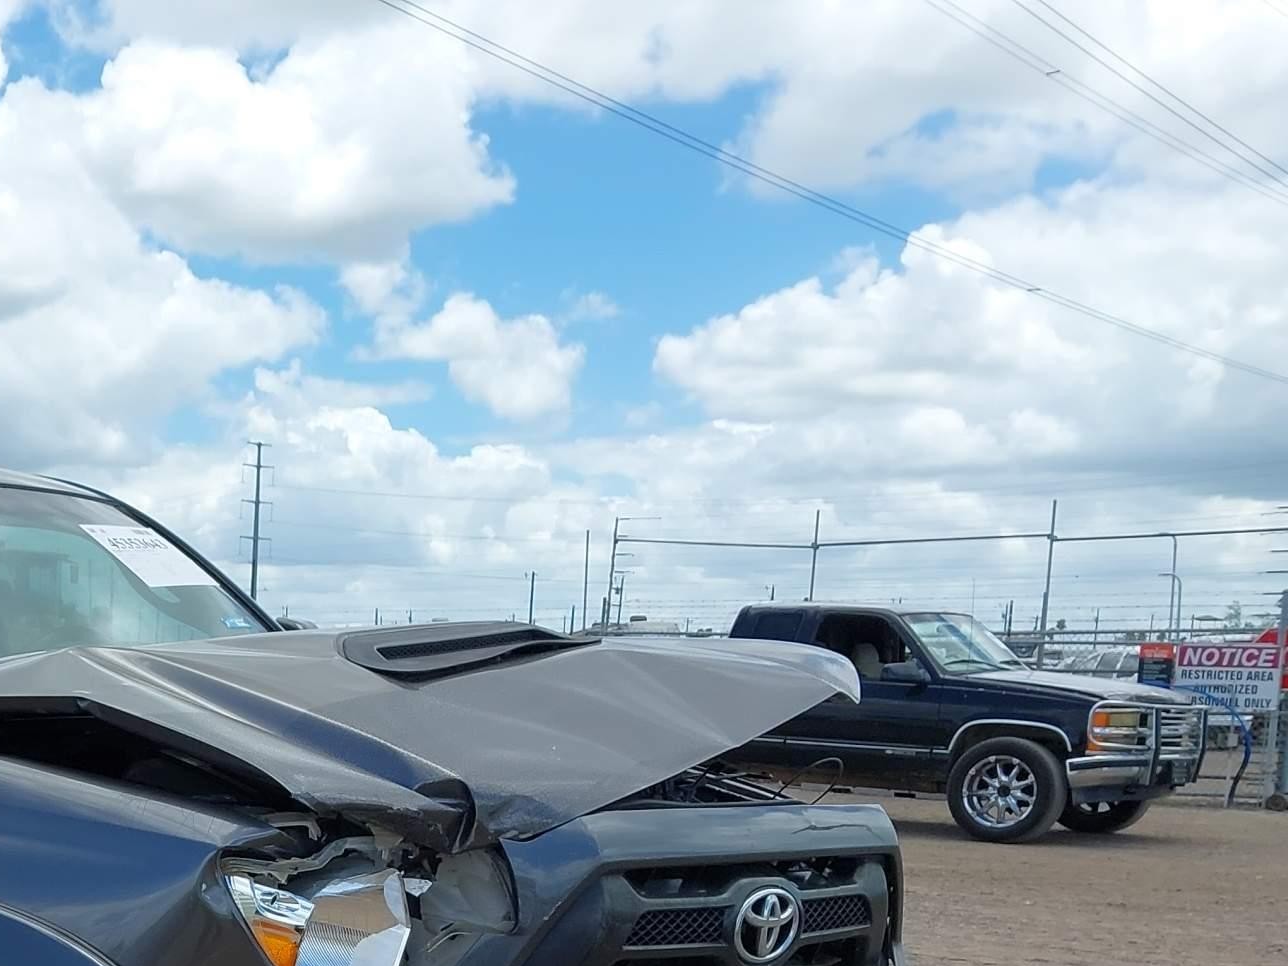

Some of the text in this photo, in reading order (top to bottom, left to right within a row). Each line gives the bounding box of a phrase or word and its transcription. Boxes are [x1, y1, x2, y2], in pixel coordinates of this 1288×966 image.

[1182, 647, 1277, 667] NOTICE
[1181, 669, 1243, 681] RESTRICTED
[1246, 670, 1274, 681] AREA
[1244, 698, 1273, 708] ONLY
